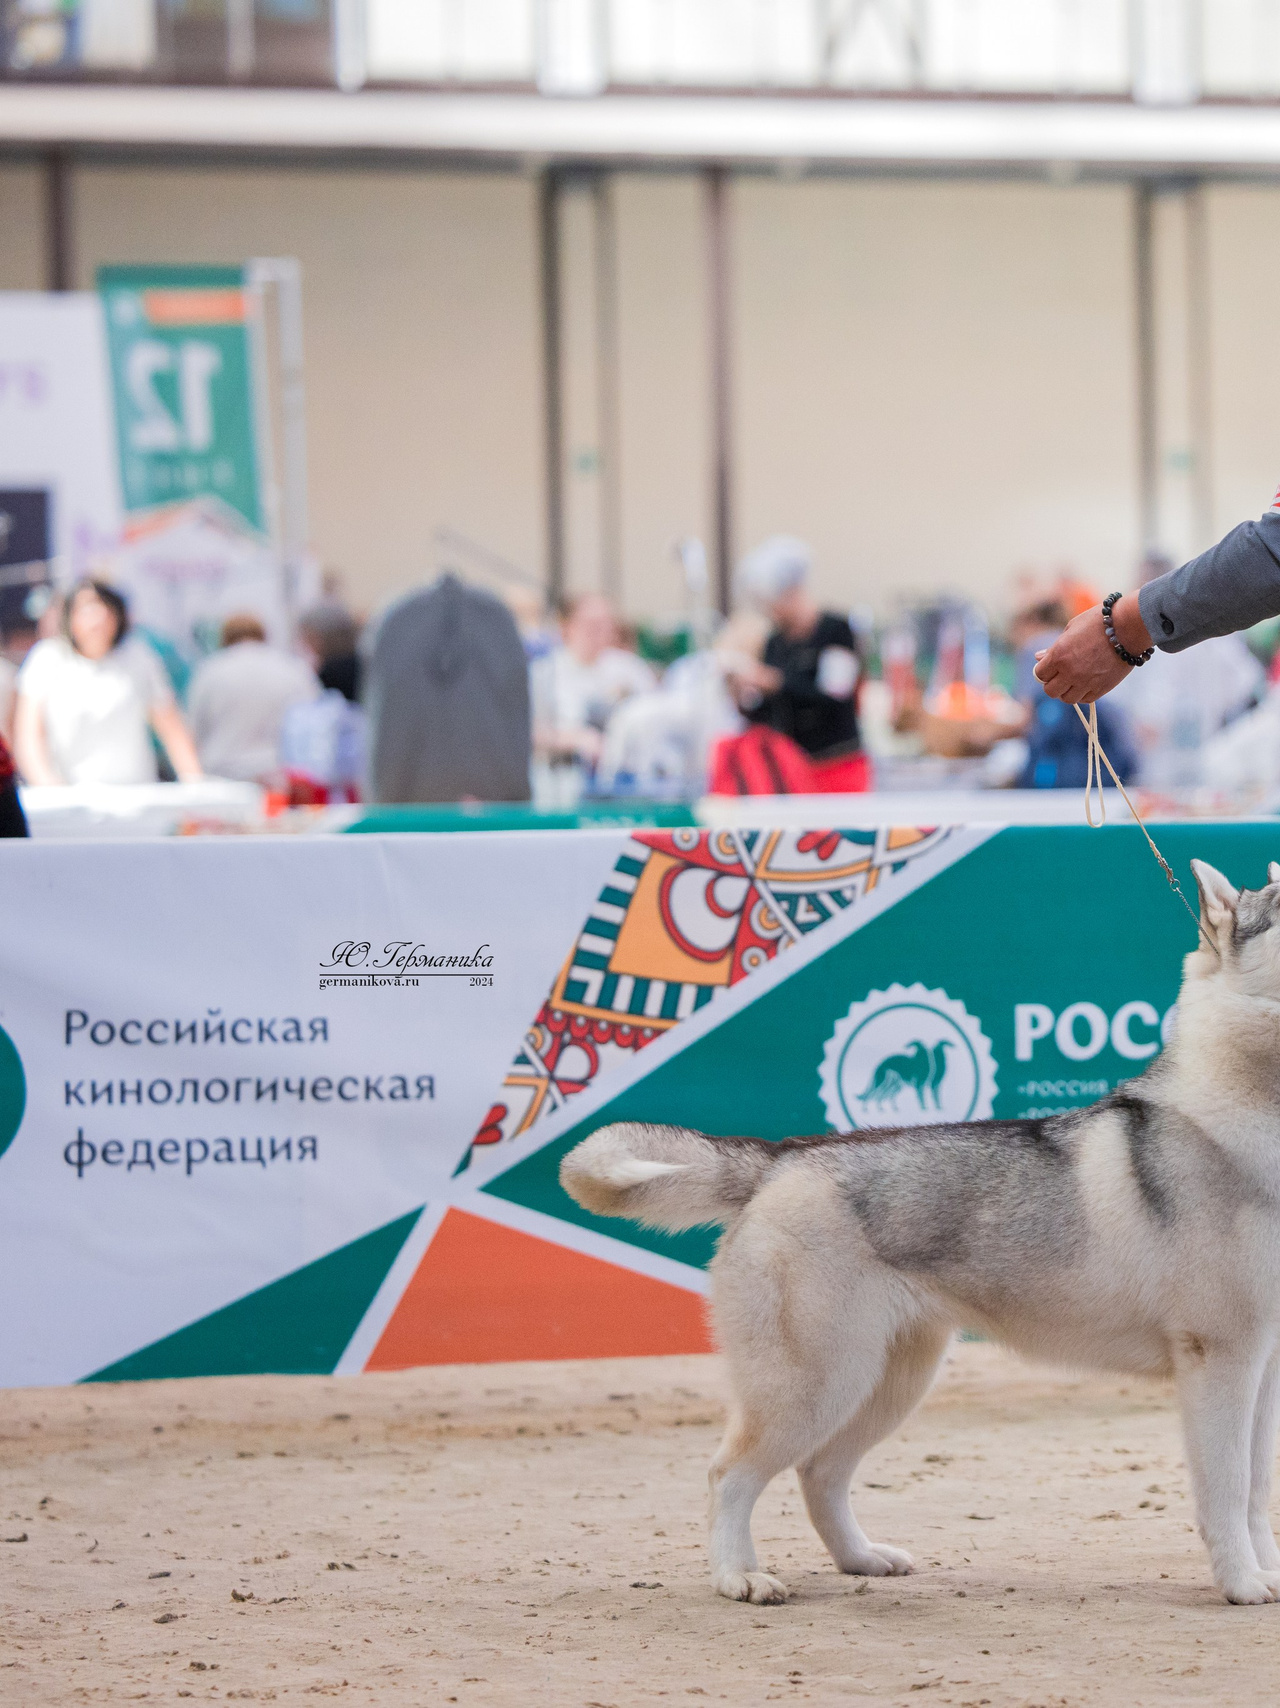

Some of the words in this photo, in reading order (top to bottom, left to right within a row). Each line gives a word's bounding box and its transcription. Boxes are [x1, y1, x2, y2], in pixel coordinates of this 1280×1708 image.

[64, 1008, 330, 1047] Российская
[64, 1074, 437, 1107] кинологическая
[64, 1127, 319, 1179] федерация
